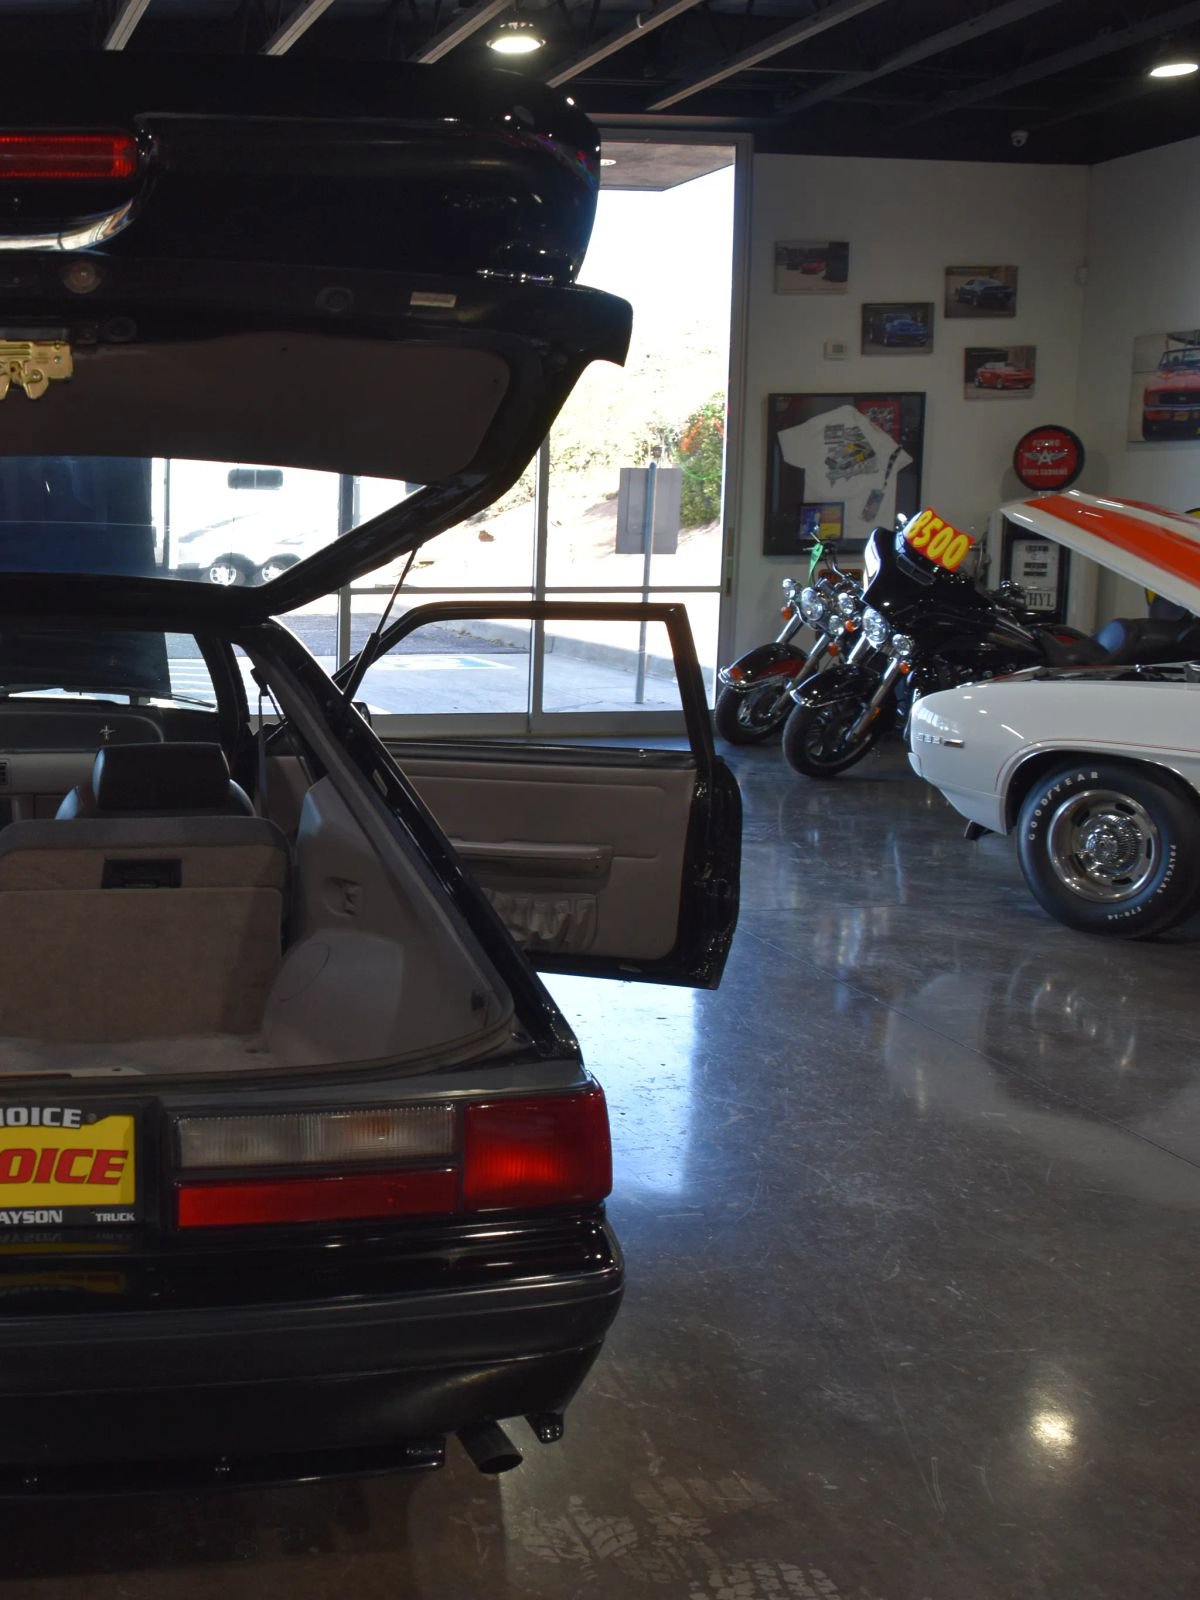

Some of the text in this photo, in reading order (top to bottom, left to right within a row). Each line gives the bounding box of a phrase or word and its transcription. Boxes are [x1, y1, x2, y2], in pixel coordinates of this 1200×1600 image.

[907, 510, 969, 570] 8500
[1028, 771, 1099, 841] GOODYEAR
[95, 1212, 136, 1223] TRUCK
